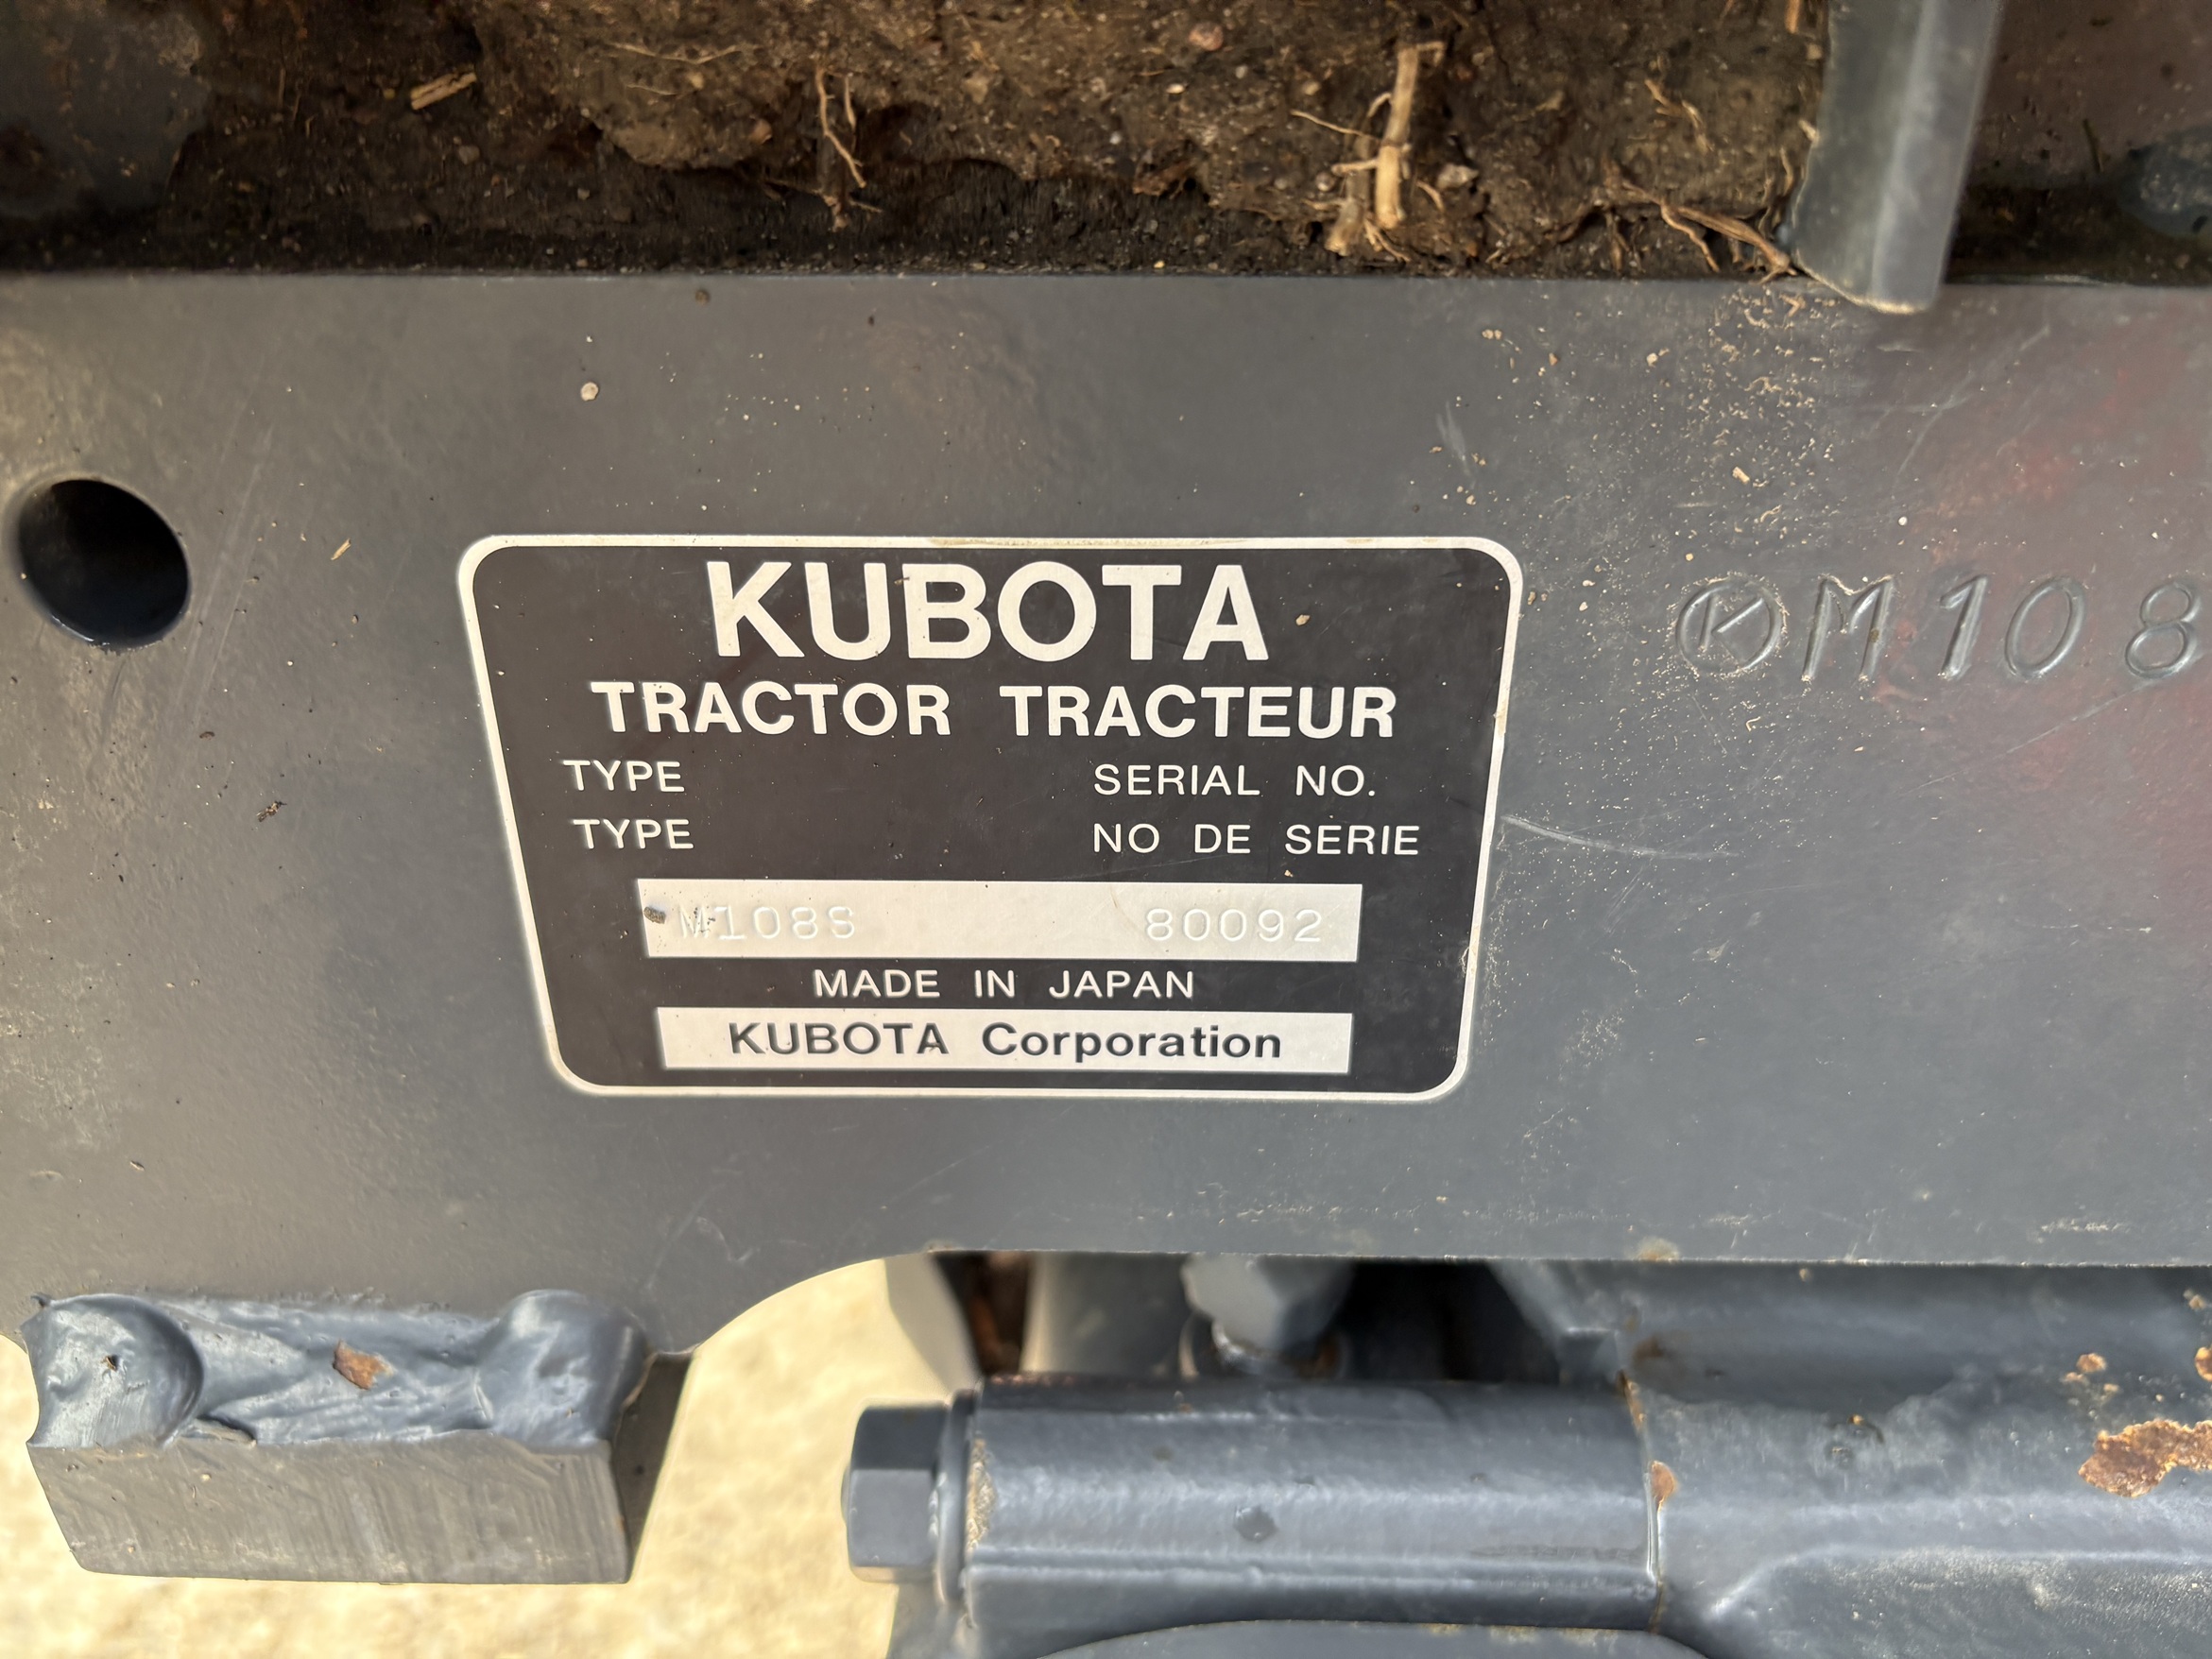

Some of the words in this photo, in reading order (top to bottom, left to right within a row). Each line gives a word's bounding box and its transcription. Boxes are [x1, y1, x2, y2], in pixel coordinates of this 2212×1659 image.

[707, 560, 1268, 662] KUBOTA
[1802, 573, 2202, 680] M108
[591, 680, 951, 736] TRACTOR
[1000, 684, 1397, 738] TRACTEUR
[563, 760, 684, 792] TYPE
[1094, 764, 1260, 796] SERIAL
[1295, 765, 1376, 797] NO.
[573, 818, 694, 848] TYPE
[1093, 823, 1160, 853] NO
[1194, 824, 1251, 854] DE
[1285, 825, 1419, 856] SERIE
[677, 905, 856, 941] M108S
[1145, 908, 1323, 944] 80092
[813, 968, 940, 999] MADE
[974, 969, 1016, 998] IN
[1049, 969, 1194, 1000] JAPAN
[729, 1020, 949, 1056] KUBOTA
[981, 1020, 1281, 1064] Corporation
